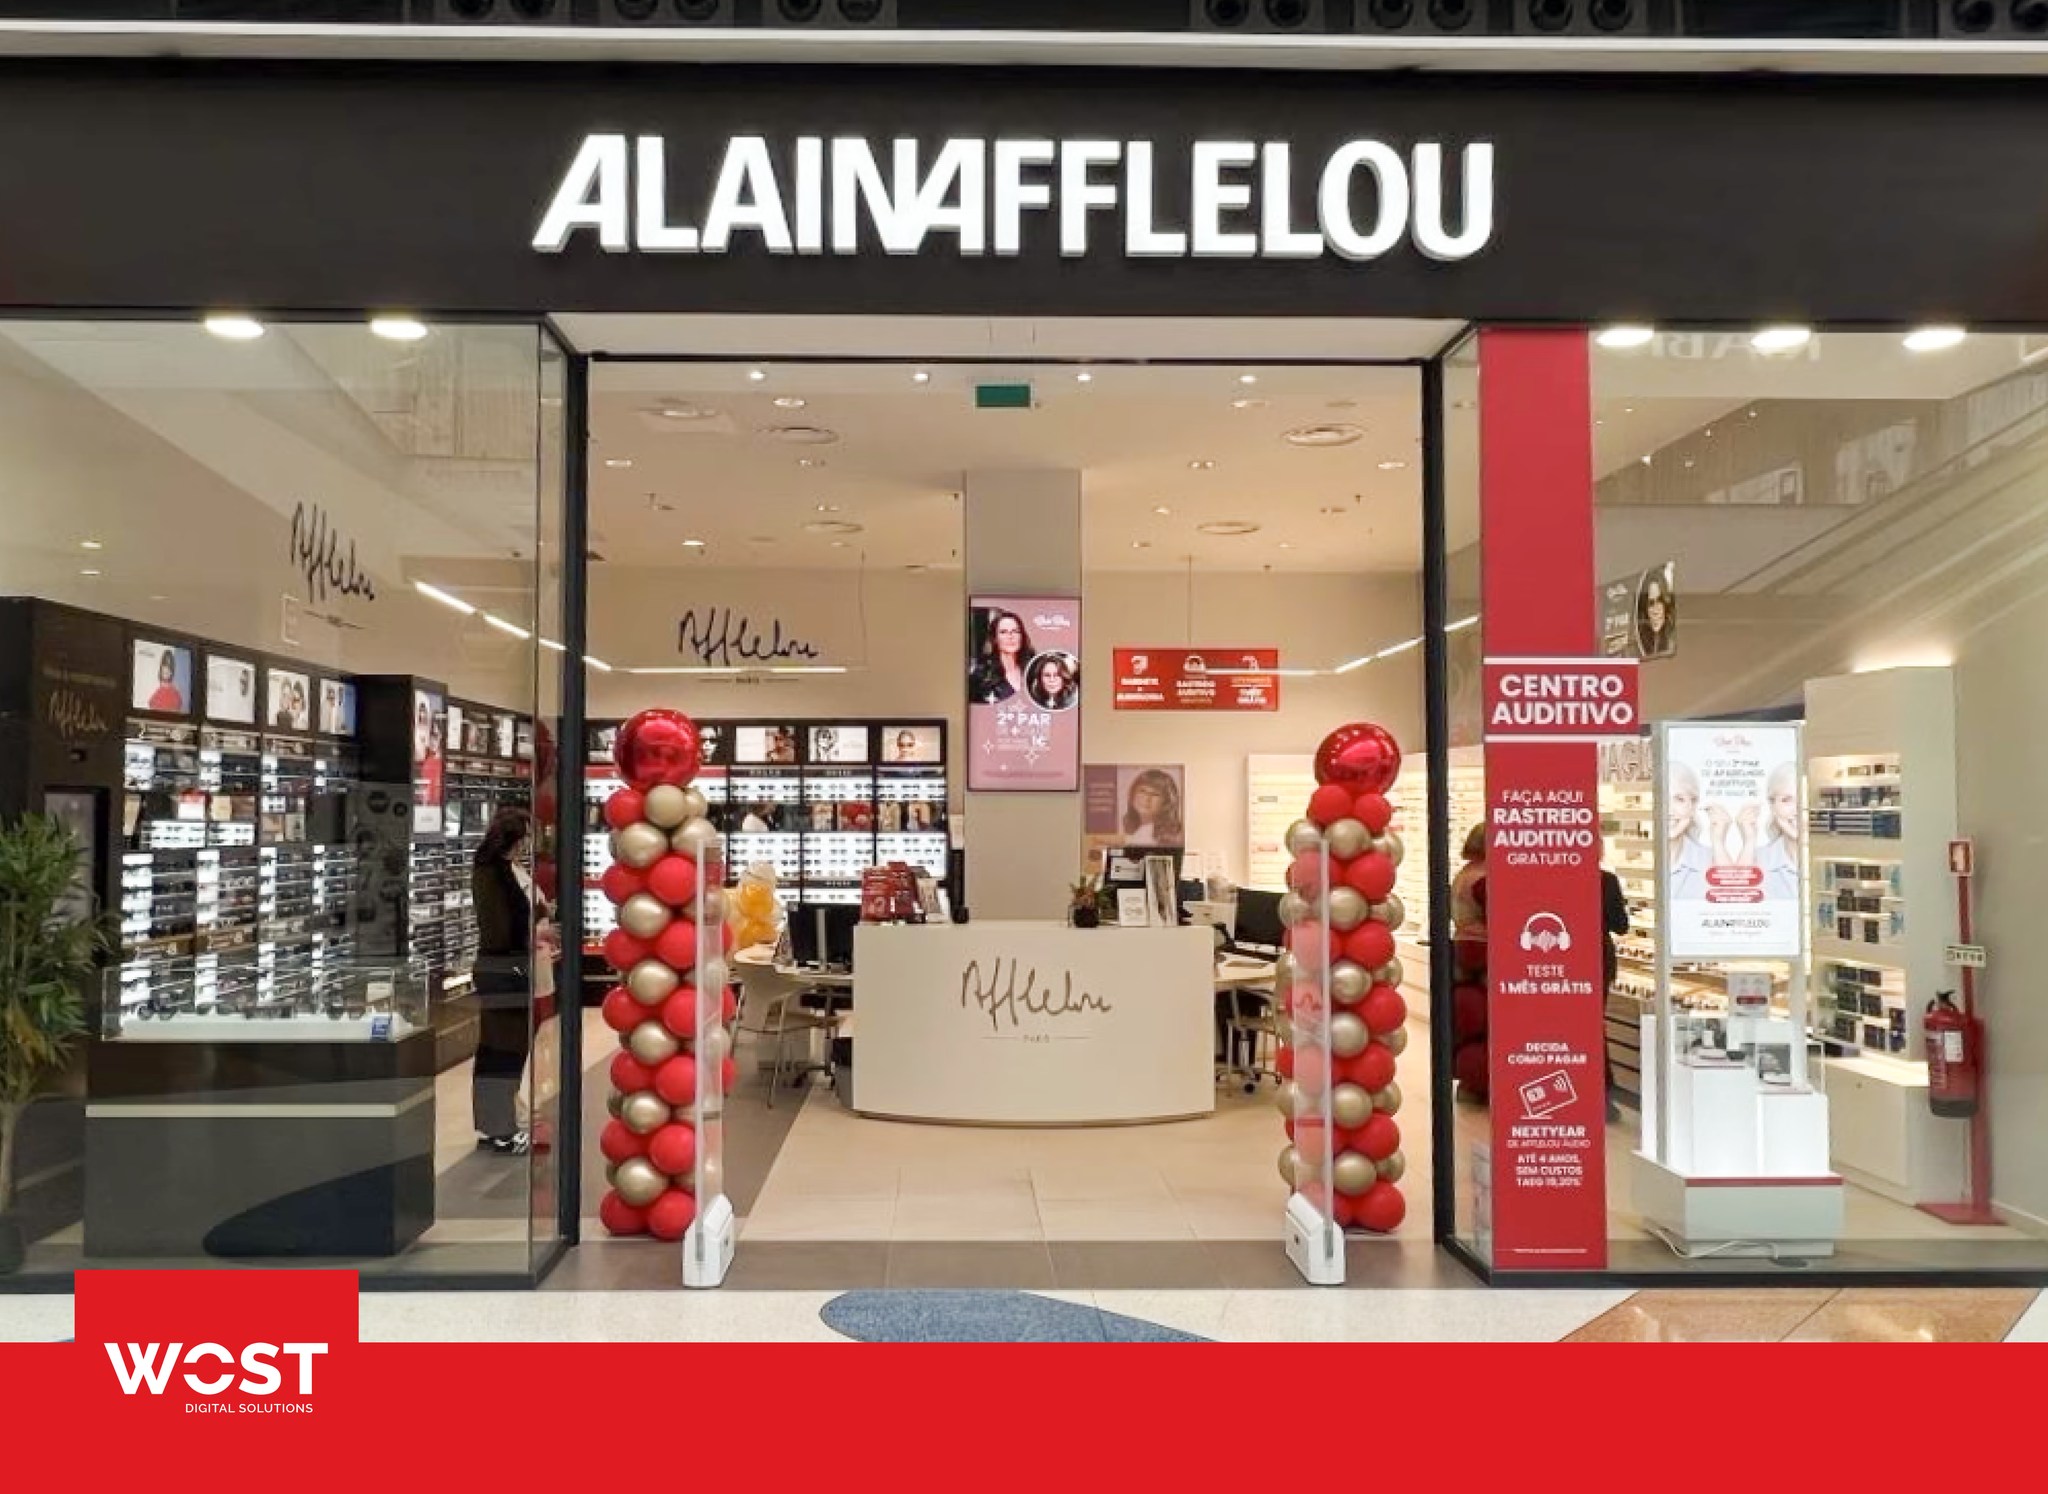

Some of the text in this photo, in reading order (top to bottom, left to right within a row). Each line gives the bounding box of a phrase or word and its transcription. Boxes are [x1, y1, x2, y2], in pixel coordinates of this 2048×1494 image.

[1500, 674, 1624, 698] CENTRO
[1017, 713, 1050, 726] PAR
[1491, 701, 1633, 725] AUDITIVO
[1503, 790, 1583, 806] FAÇA AQUI
[1493, 807, 1593, 825] RASTREIO
[1494, 830, 1593, 847] AUDITIVO
[1507, 853, 1582, 866] GRATUITO
[1526, 964, 1565, 978] TESTE
[1508, 979, 1537, 994] MÊS
[1541, 979, 1593, 994] GRÁTIS
[1526, 1043, 1569, 1052] DECIDA
[1508, 1055, 1587, 1064] COMO PAGAR
[1512, 1125, 1585, 1137] NEXTYEAR
[1541, 1166, 1583, 1176] CUSTOS
